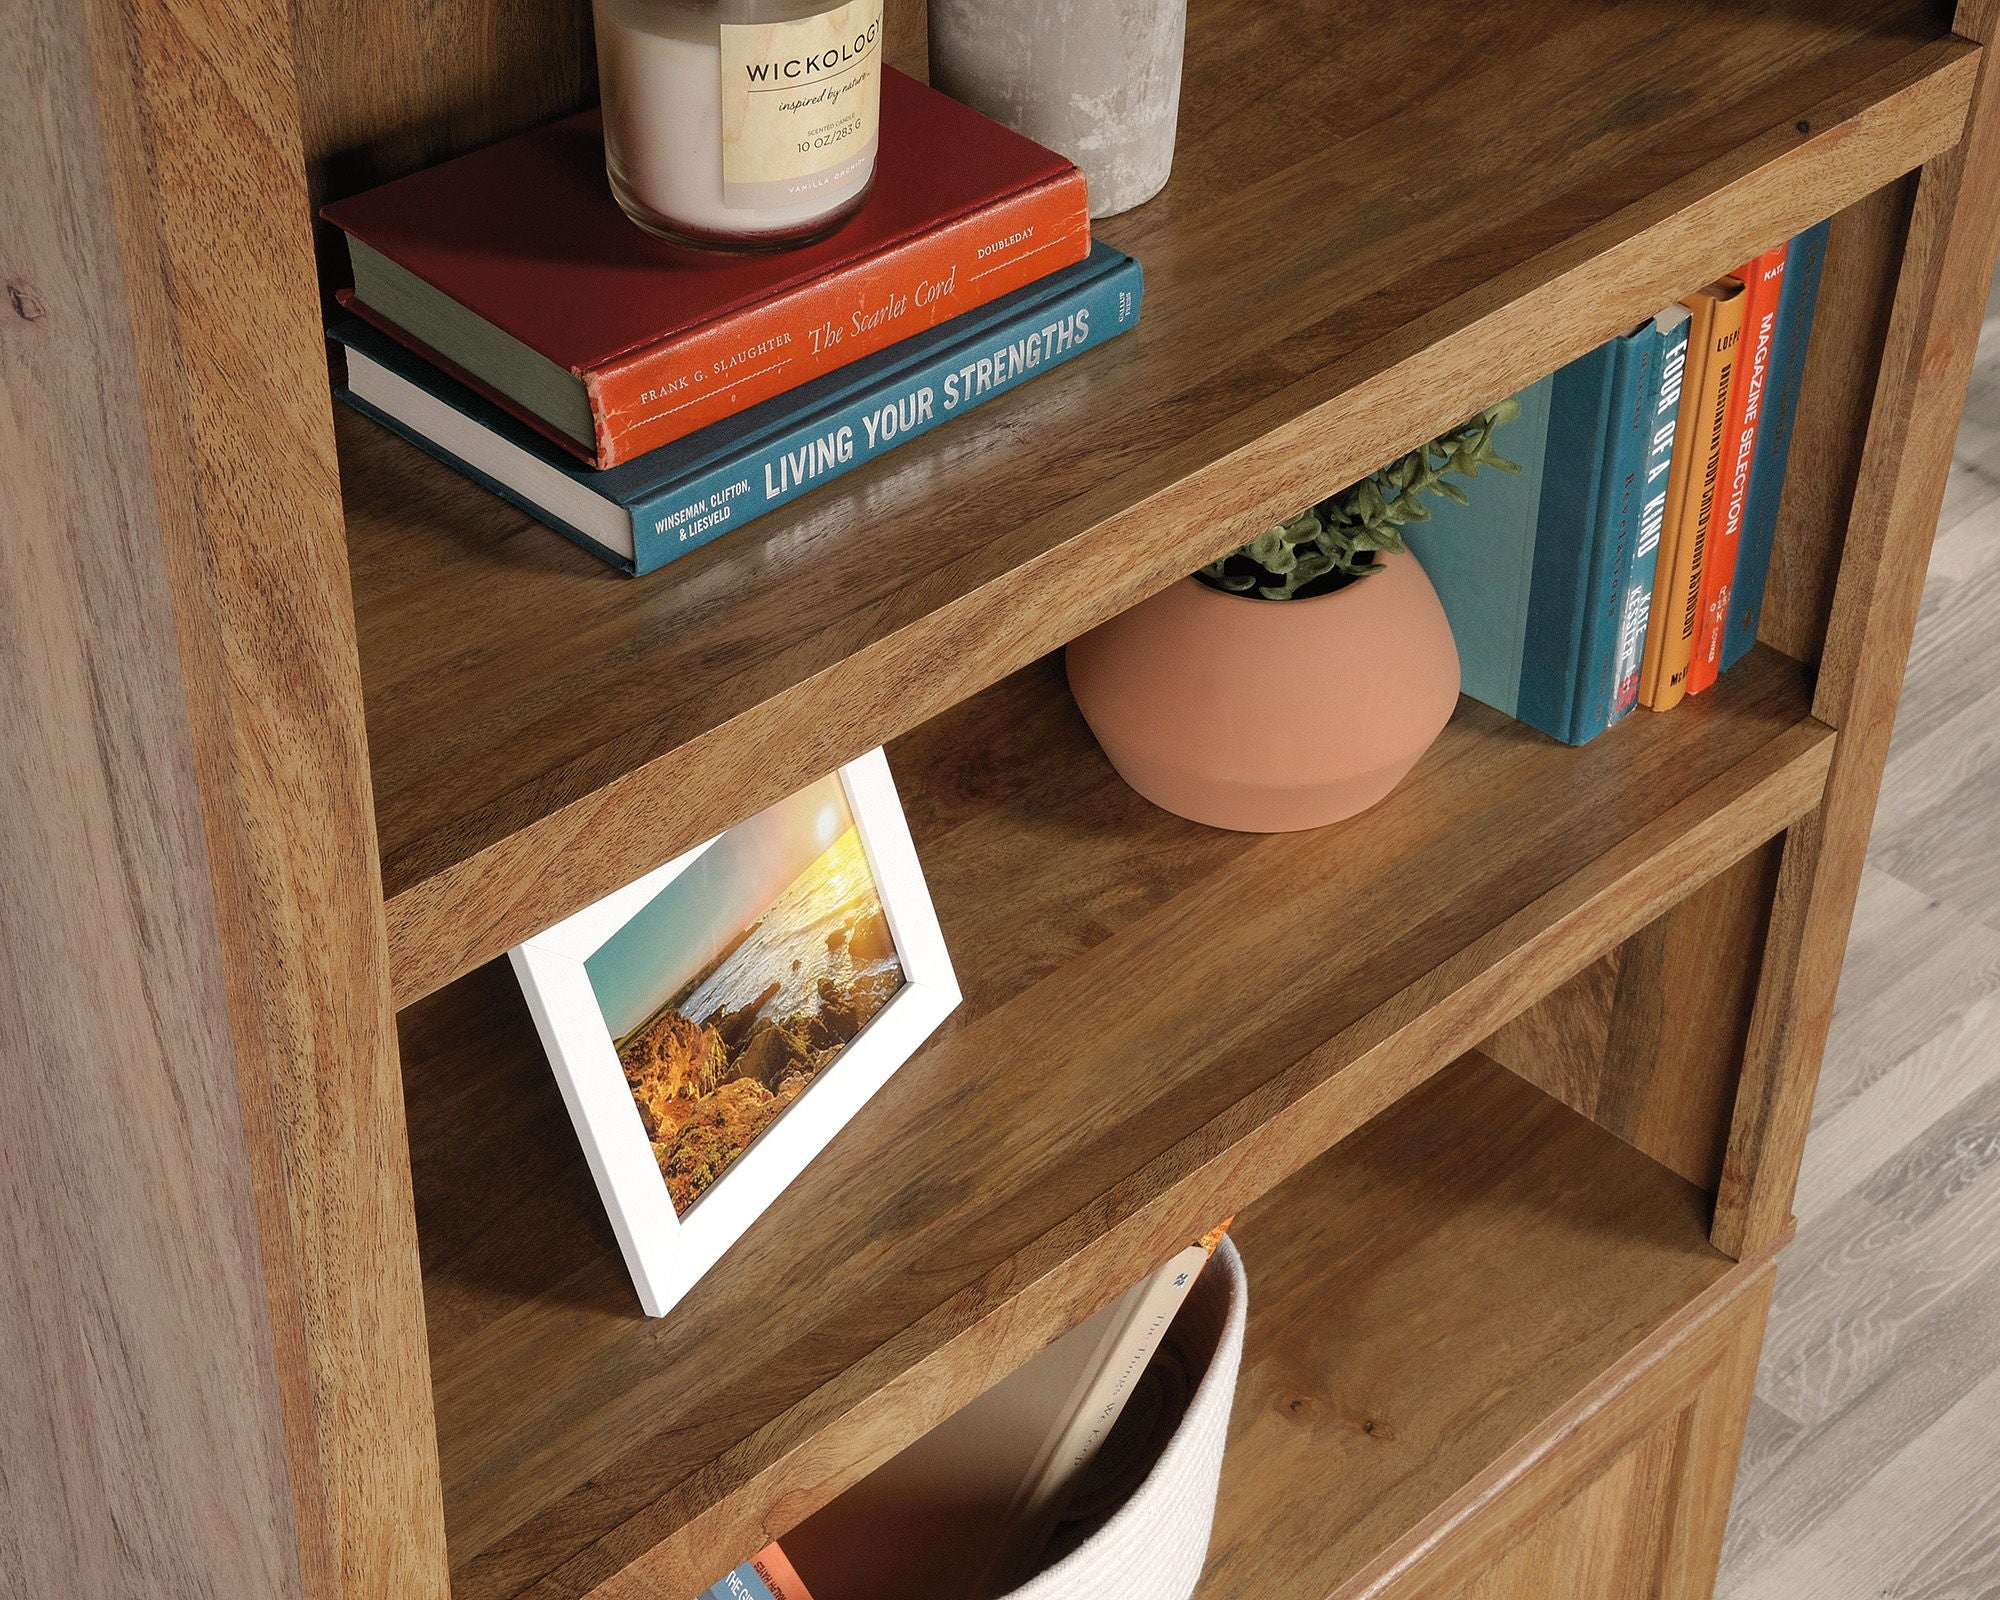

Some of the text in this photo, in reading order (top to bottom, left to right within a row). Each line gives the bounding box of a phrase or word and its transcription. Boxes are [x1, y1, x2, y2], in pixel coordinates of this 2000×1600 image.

[746, 12, 881, 82] WICKOLOGY
[778, 88, 827, 114] inspired
[827, 86, 841, 105] by
[797, 118, 861, 153] 10 OZ/283 G
[807, 113, 855, 137] SCENTED CANDLE
[789, 177, 829, 193] VANILLA
[977, 226, 1035, 259] DOUBLEDAY
[1764, 260, 1785, 281] KATZ
[808, 265, 956, 356] The Scarlet Cord
[640, 331, 792, 405] FRANK G. SLAUGHTER
[763, 308, 1091, 500] LIVING YOUR STRENGTHS
[1726, 312, 1774, 535] MAGAZINE SELECTION
[1638, 339, 1687, 558] FOUR OF A KIND
[655, 478, 752, 535] WINSEMAN, CLIFTON,
[1682, 363, 1731, 640] UNDERSTANDING YOUR CHILD THROUGH ASTROLOGY
[678, 506, 731, 542] & LIESVELD
[1608, 472, 1634, 617] Revelations
[1622, 585, 1642, 660] KESSLER
[1636, 592, 1651, 635] KATE
[1099, 1402, 1116, 1423] We
[1075, 1429, 1101, 1466] Keep
[725, 1570, 743, 1597] THE
[754, 1561, 773, 1584] HAYES
